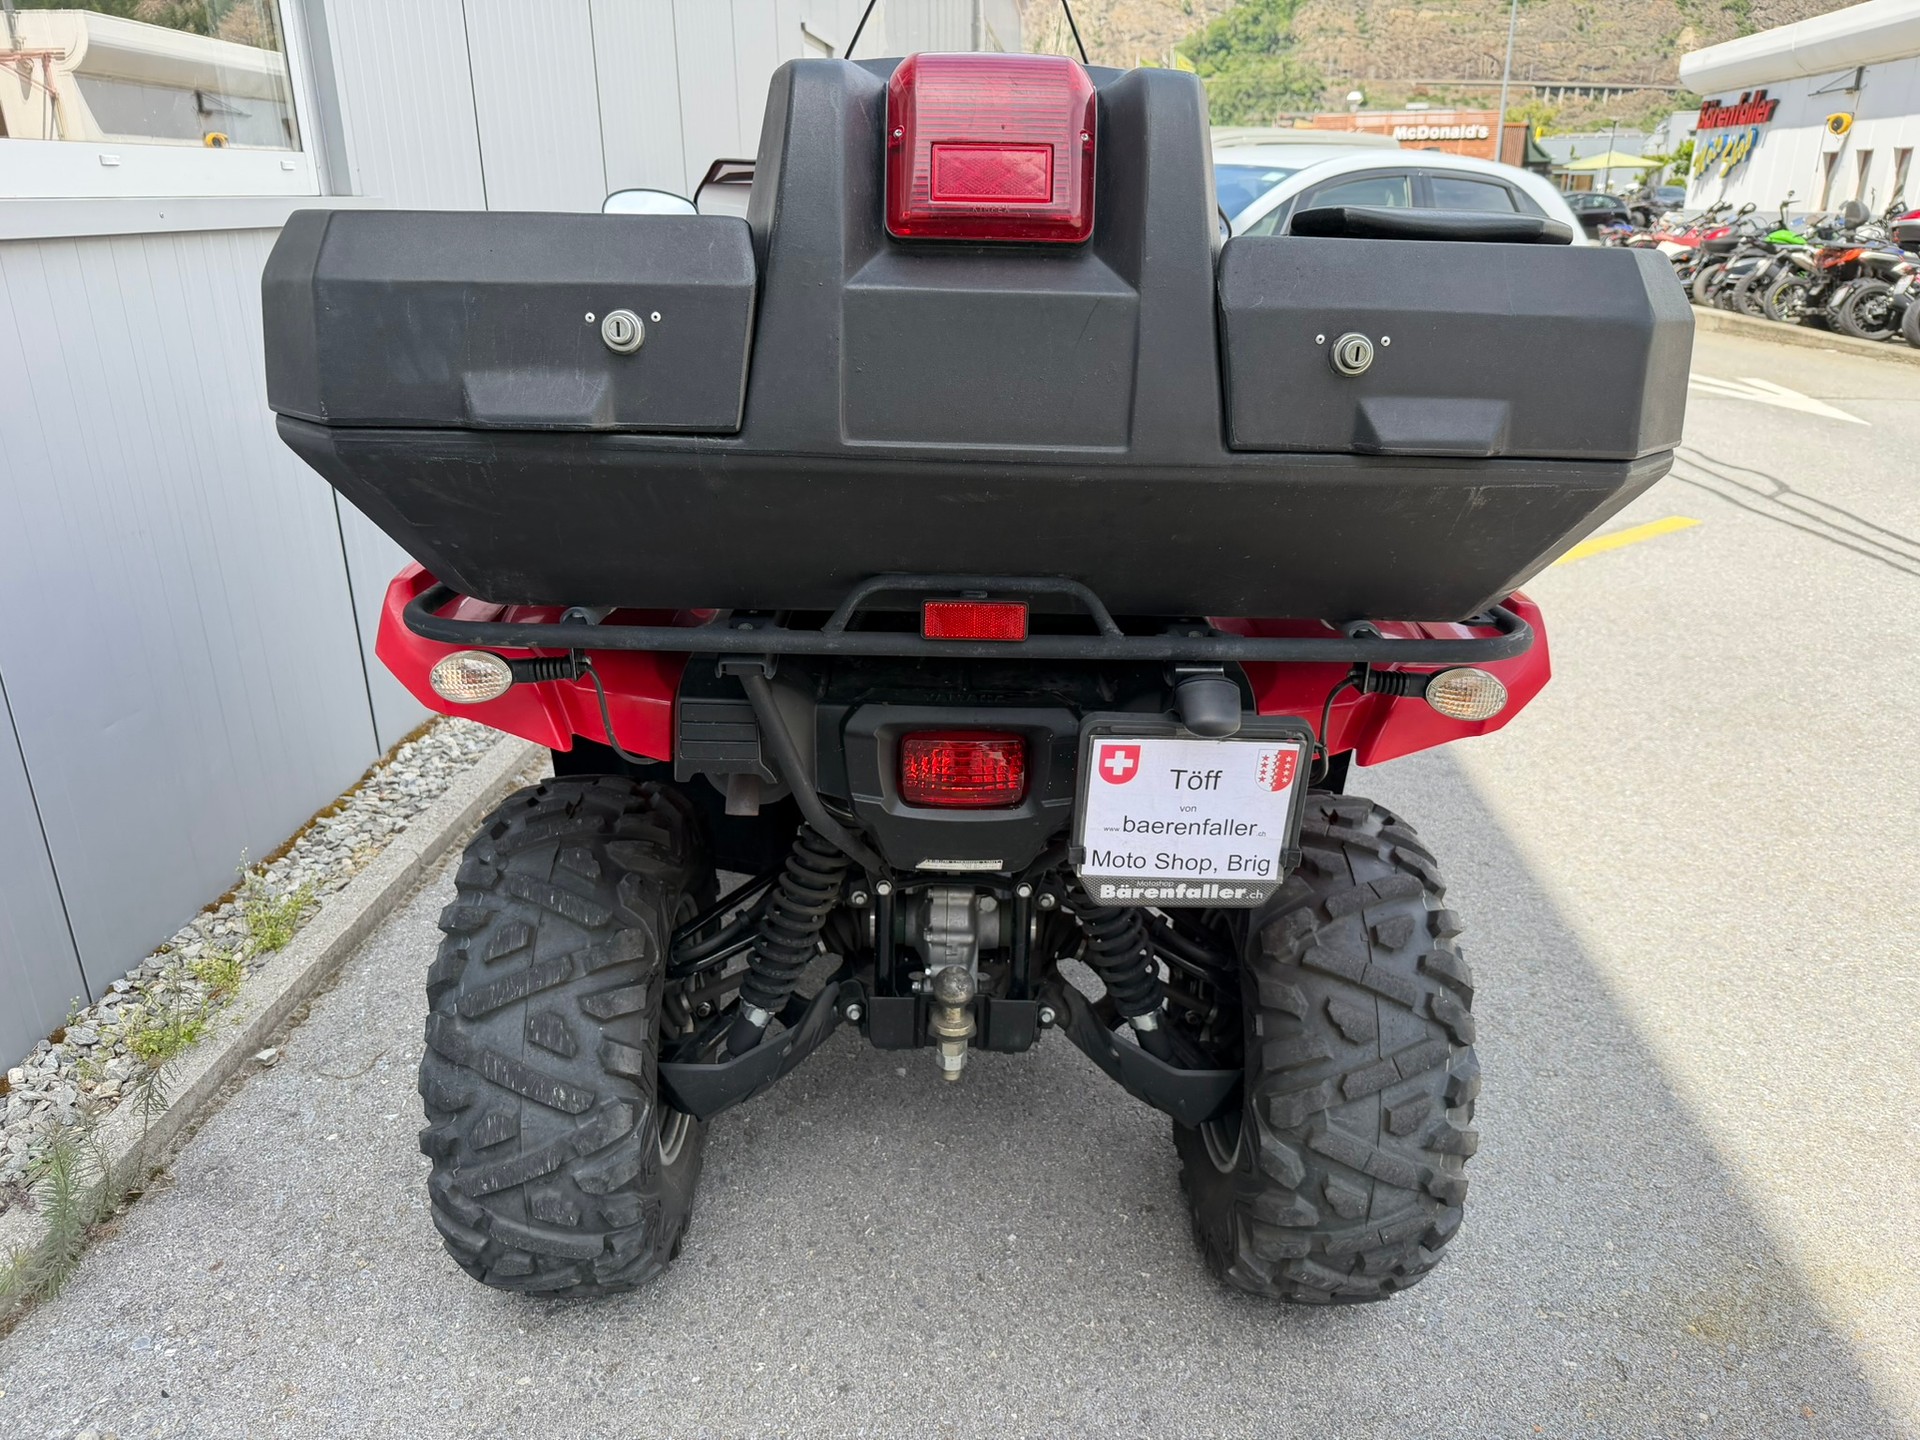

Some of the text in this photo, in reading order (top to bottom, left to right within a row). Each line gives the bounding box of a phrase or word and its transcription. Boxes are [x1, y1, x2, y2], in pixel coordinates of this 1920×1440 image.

[1392, 124, 1490, 141] McDonald's
[1170, 768, 1223, 791] Töff
[1179, 805, 1197, 813] von
[1091, 849, 1271, 876] Moto Shop, Brig
